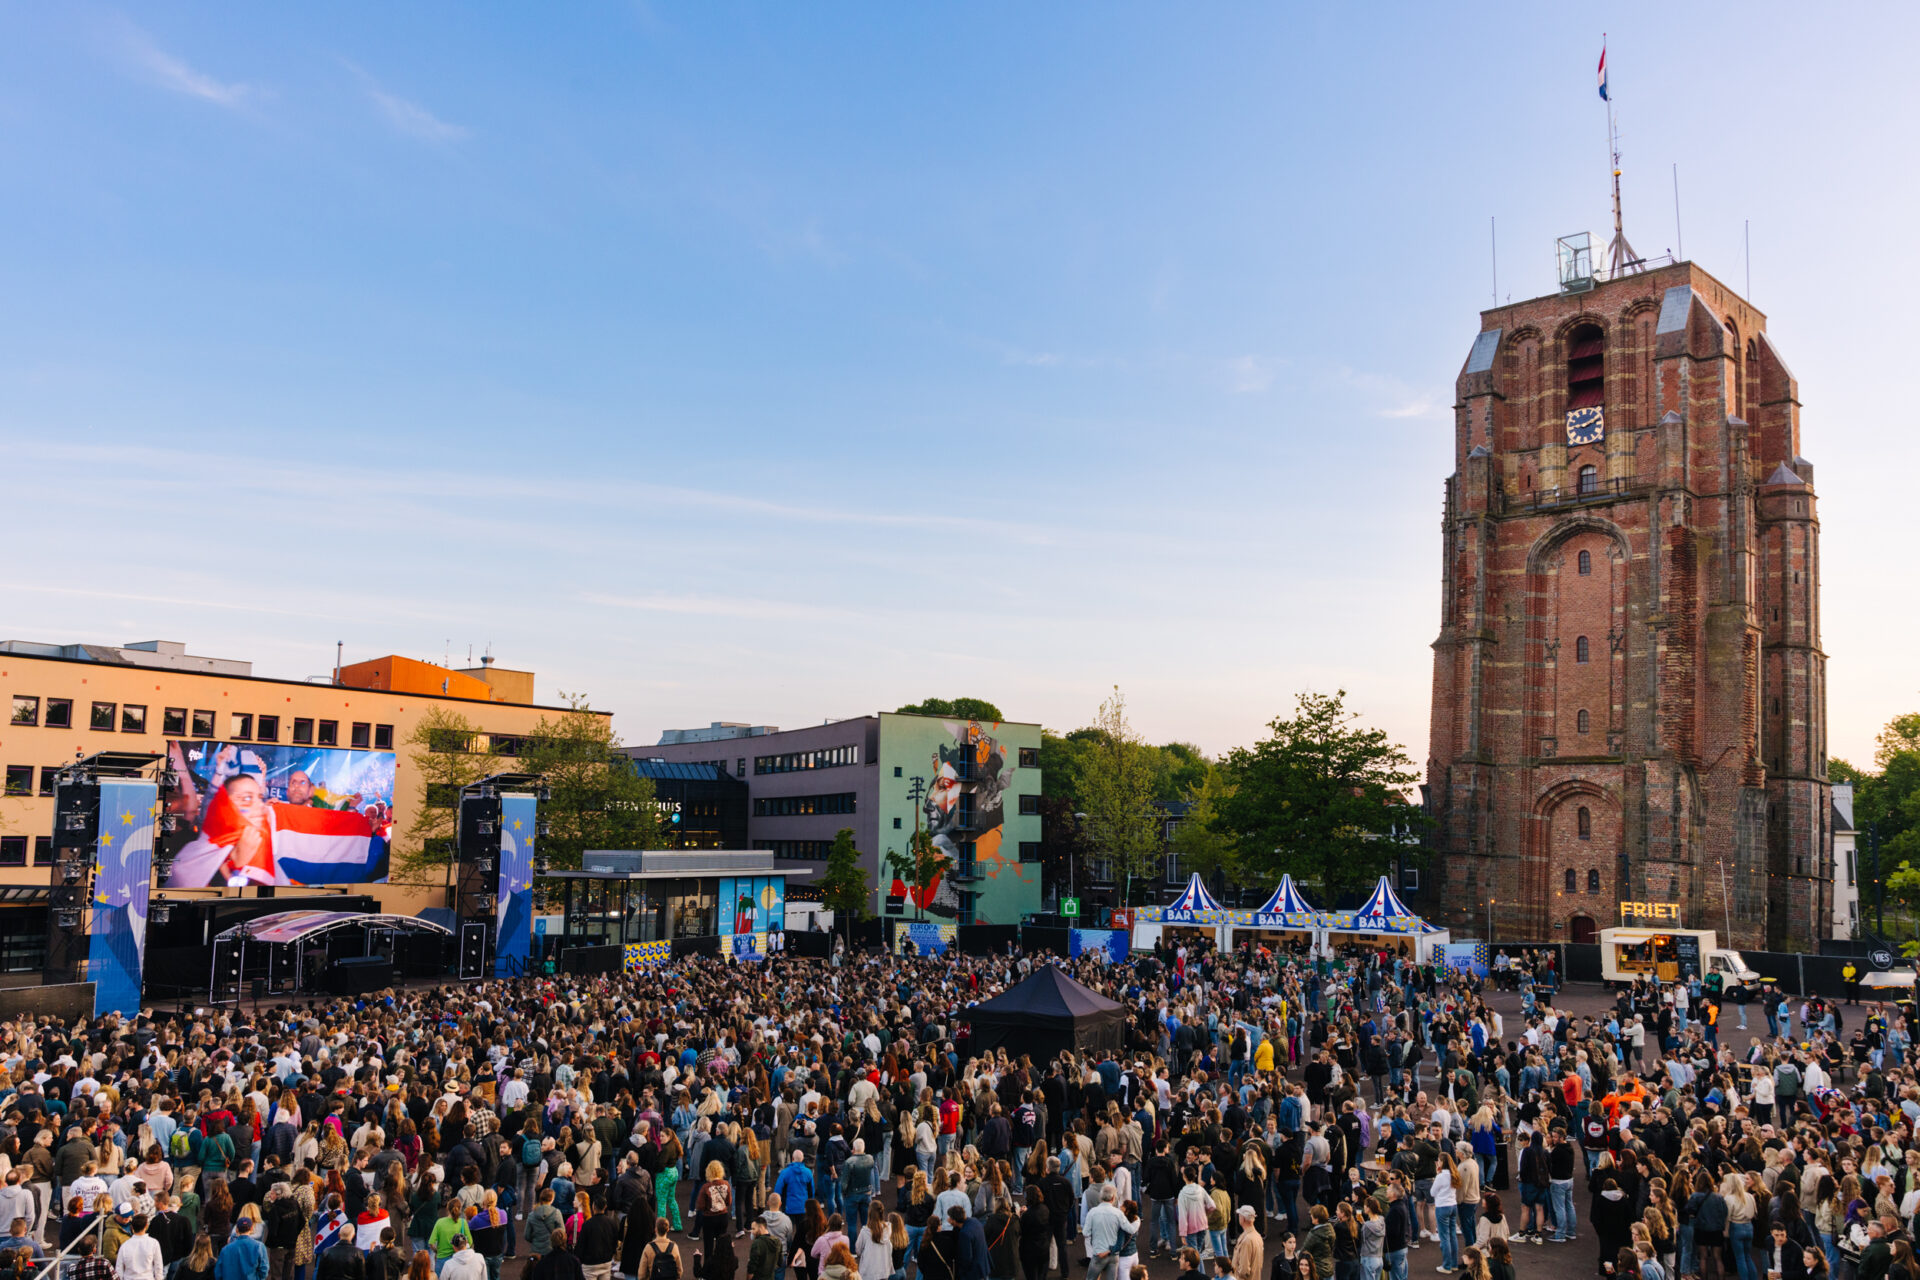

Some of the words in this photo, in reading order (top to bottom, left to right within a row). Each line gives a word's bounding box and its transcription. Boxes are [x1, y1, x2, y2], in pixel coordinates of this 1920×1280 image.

[1167, 910, 1191, 921] BAR
[1620, 901, 1680, 919] FRIET
[1258, 913, 1284, 925] BAR
[1358, 916, 1386, 929] BAR
[910, 923, 938, 931] EUROPA
[1454, 959, 1470, 967] PLEIN
[1874, 953, 1890, 963] VIES
